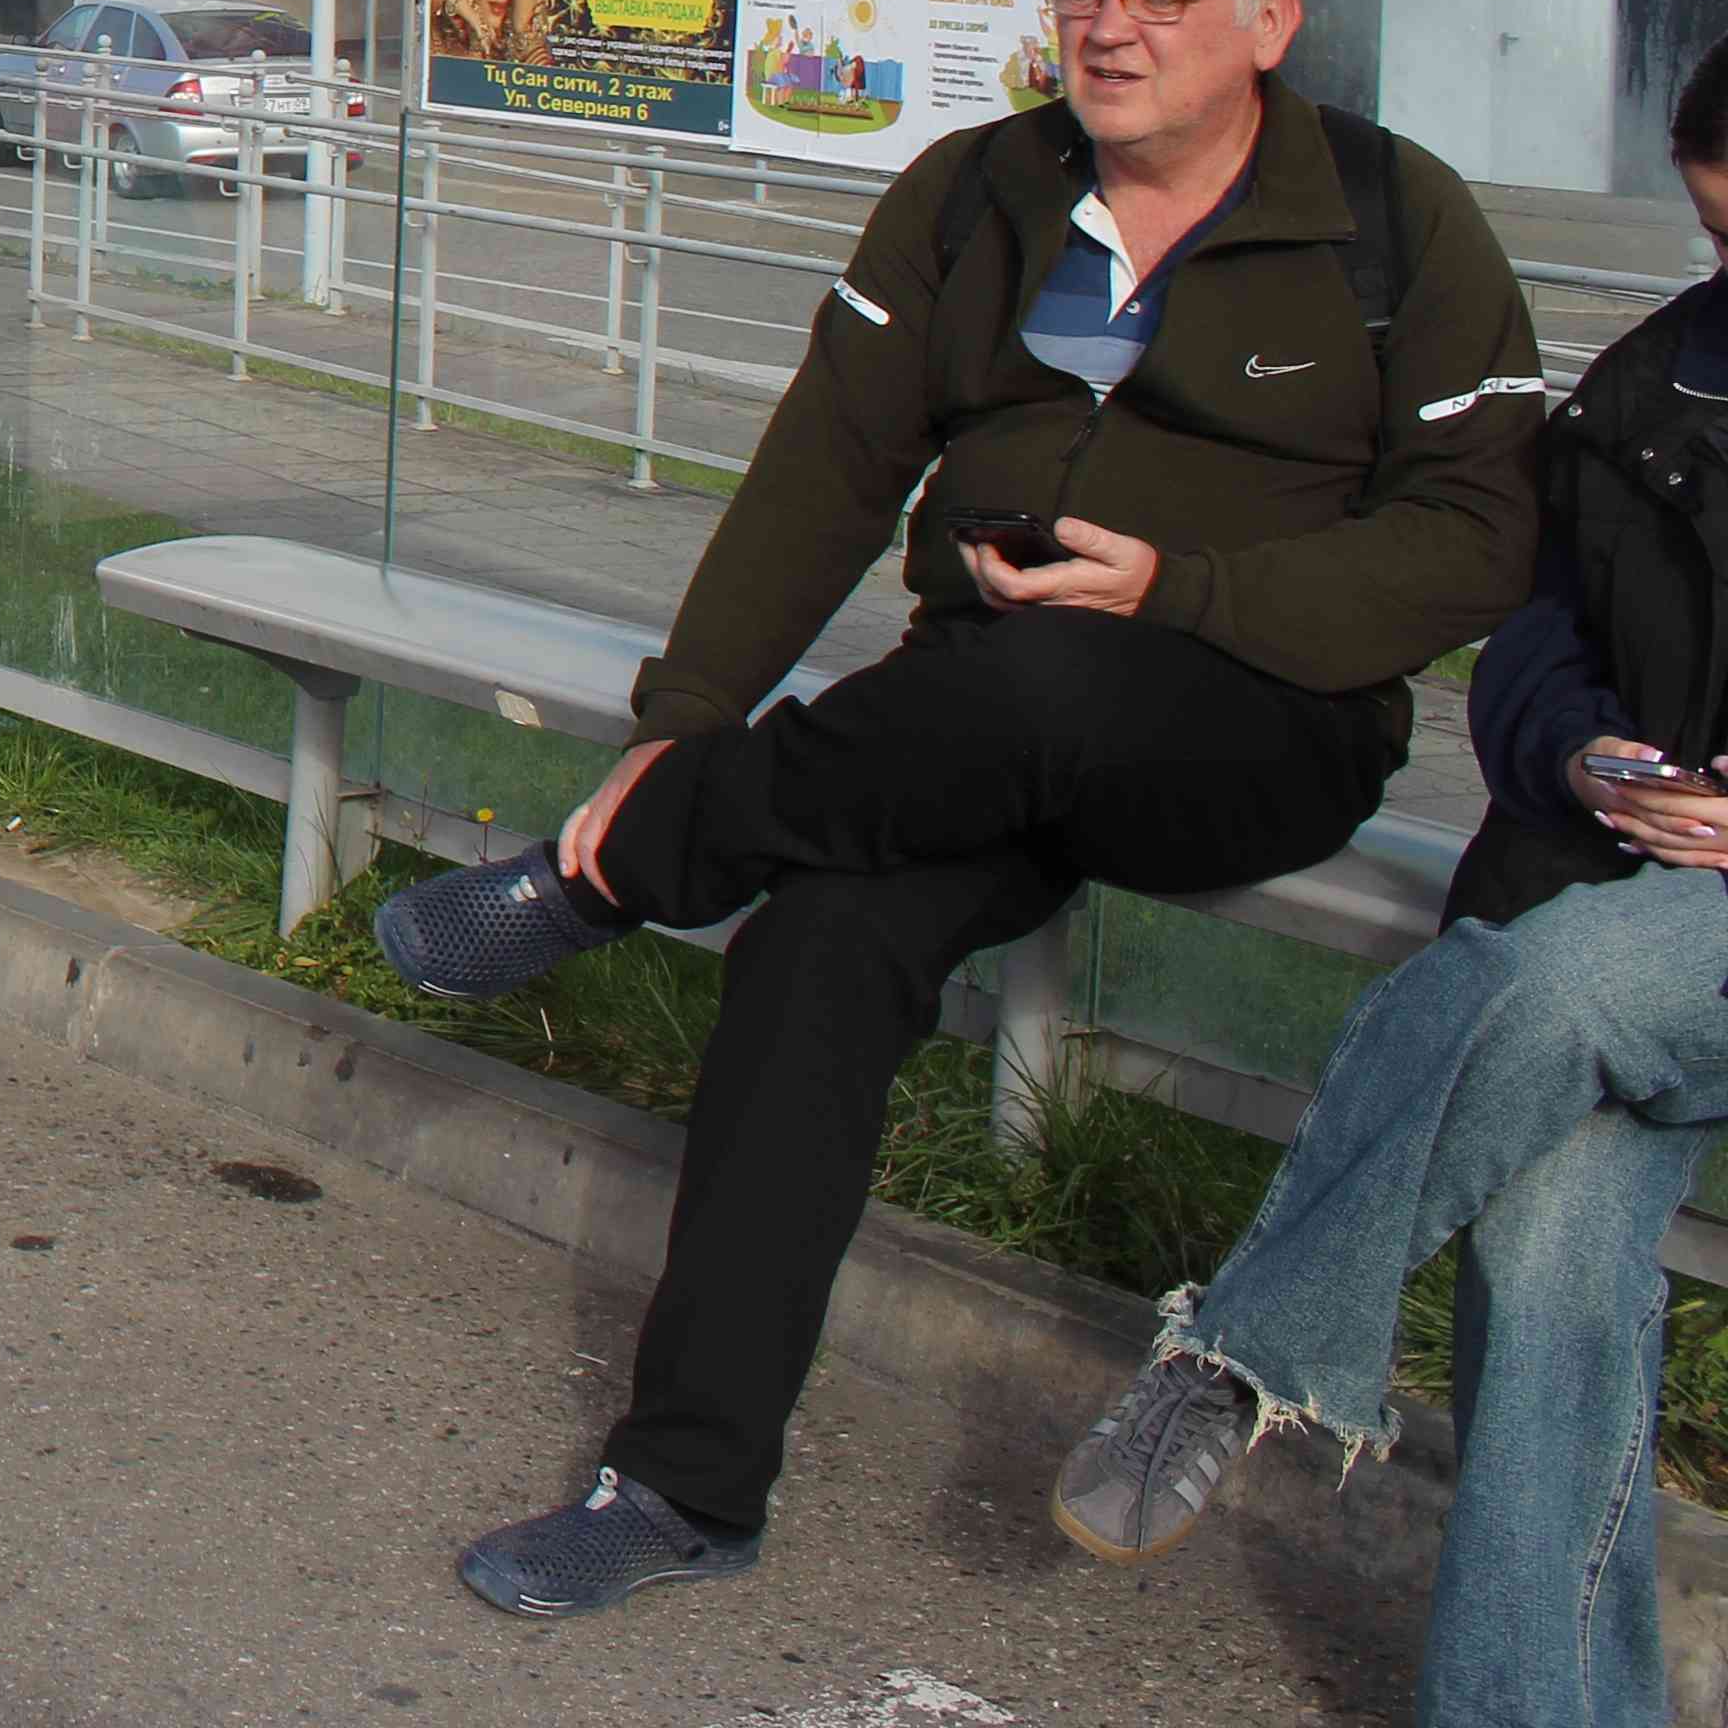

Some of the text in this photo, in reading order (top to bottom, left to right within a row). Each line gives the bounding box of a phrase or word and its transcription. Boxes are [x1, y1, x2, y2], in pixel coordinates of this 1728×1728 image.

[484, 63, 673, 102] Тц Сан сити, 2 этаж
[504, 88, 649, 121] Ул. Северная 6
